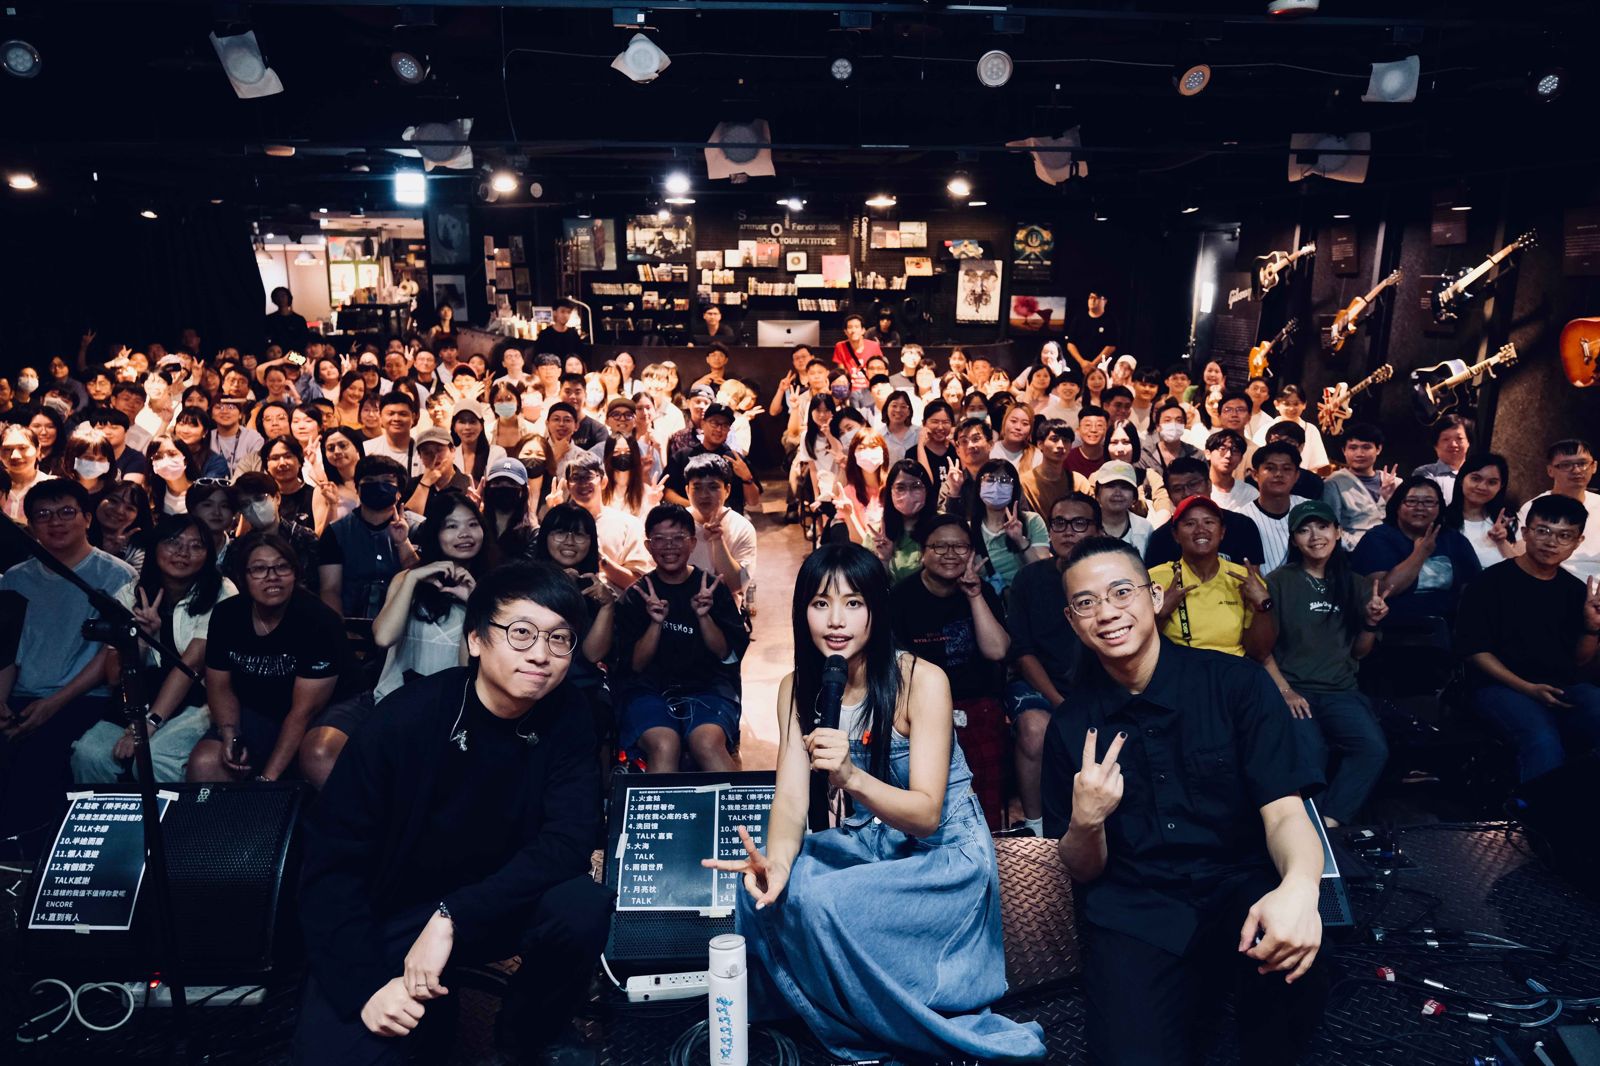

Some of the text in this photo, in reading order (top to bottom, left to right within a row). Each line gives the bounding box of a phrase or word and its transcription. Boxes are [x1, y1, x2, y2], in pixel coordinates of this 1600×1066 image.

[779, 237, 799, 246] YOUR
[800, 238, 837, 246] ATTITUDE
[628, 812, 697, 821] 3.刻在我心底的名字
[626, 842, 650, 850] 5.大海
[624, 863, 664, 871] 6.兩個世界
[633, 874, 654, 882] TALK
[631, 897, 652, 905] TALK
